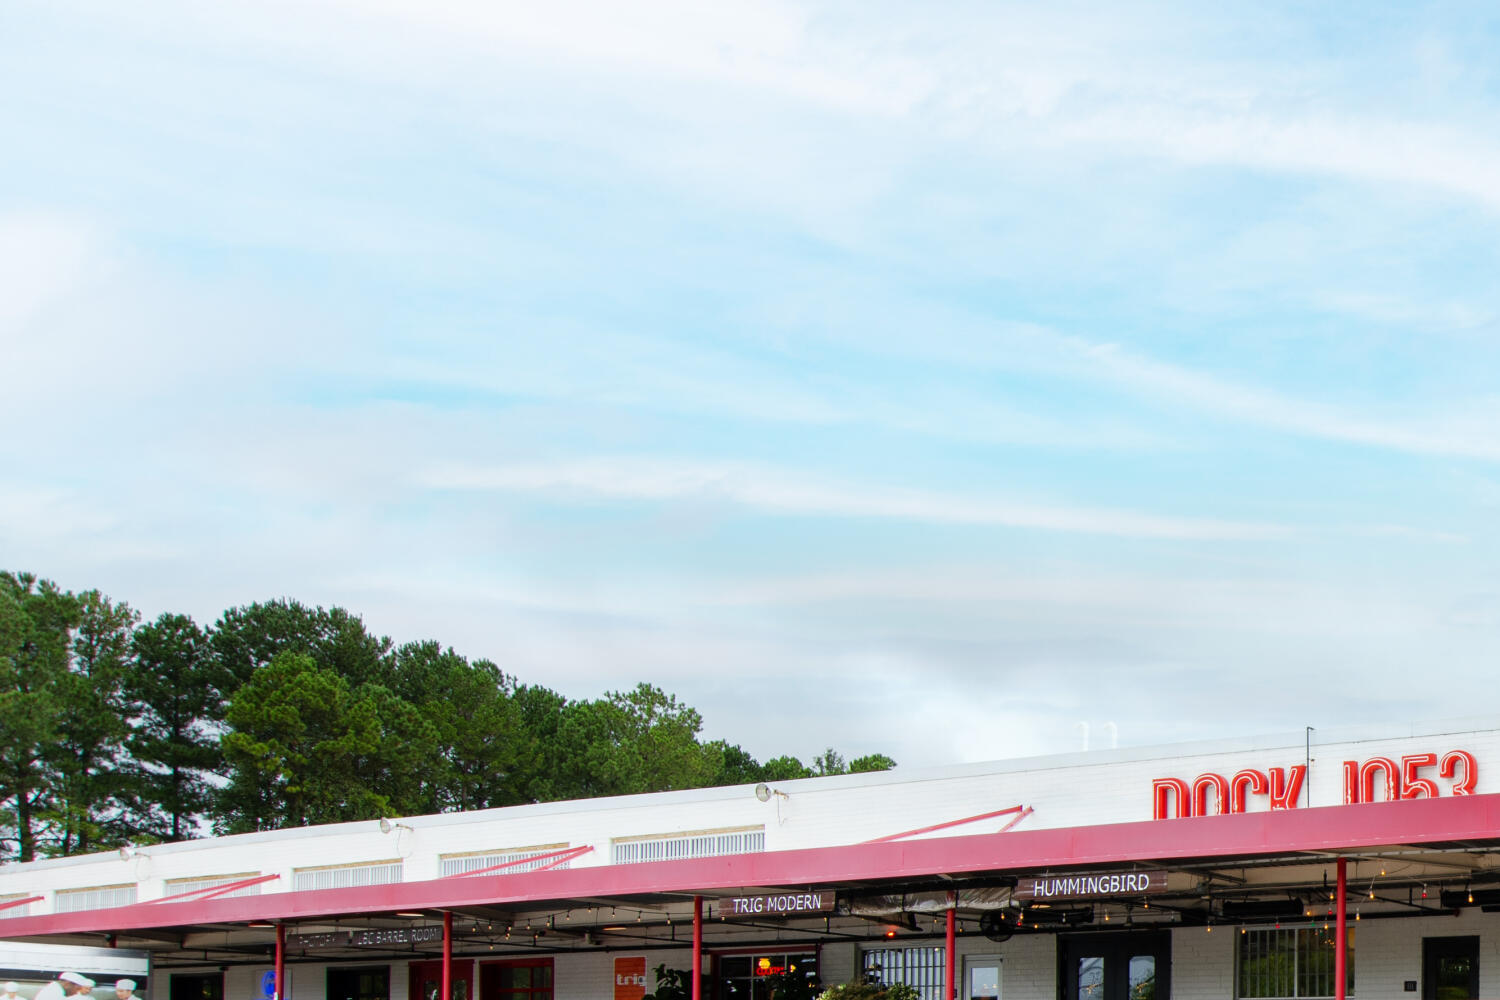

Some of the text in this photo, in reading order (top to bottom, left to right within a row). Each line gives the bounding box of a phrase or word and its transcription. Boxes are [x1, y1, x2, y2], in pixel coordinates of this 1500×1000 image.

[1152, 749, 1478, 820] DOCK 1053
[1033, 873, 1149, 897] HUMMINGBIRD
[733, 894, 821, 913] TRIG MODERN
[376, 929, 408, 944] BARREL
[411, 928, 438, 942] ROOM
